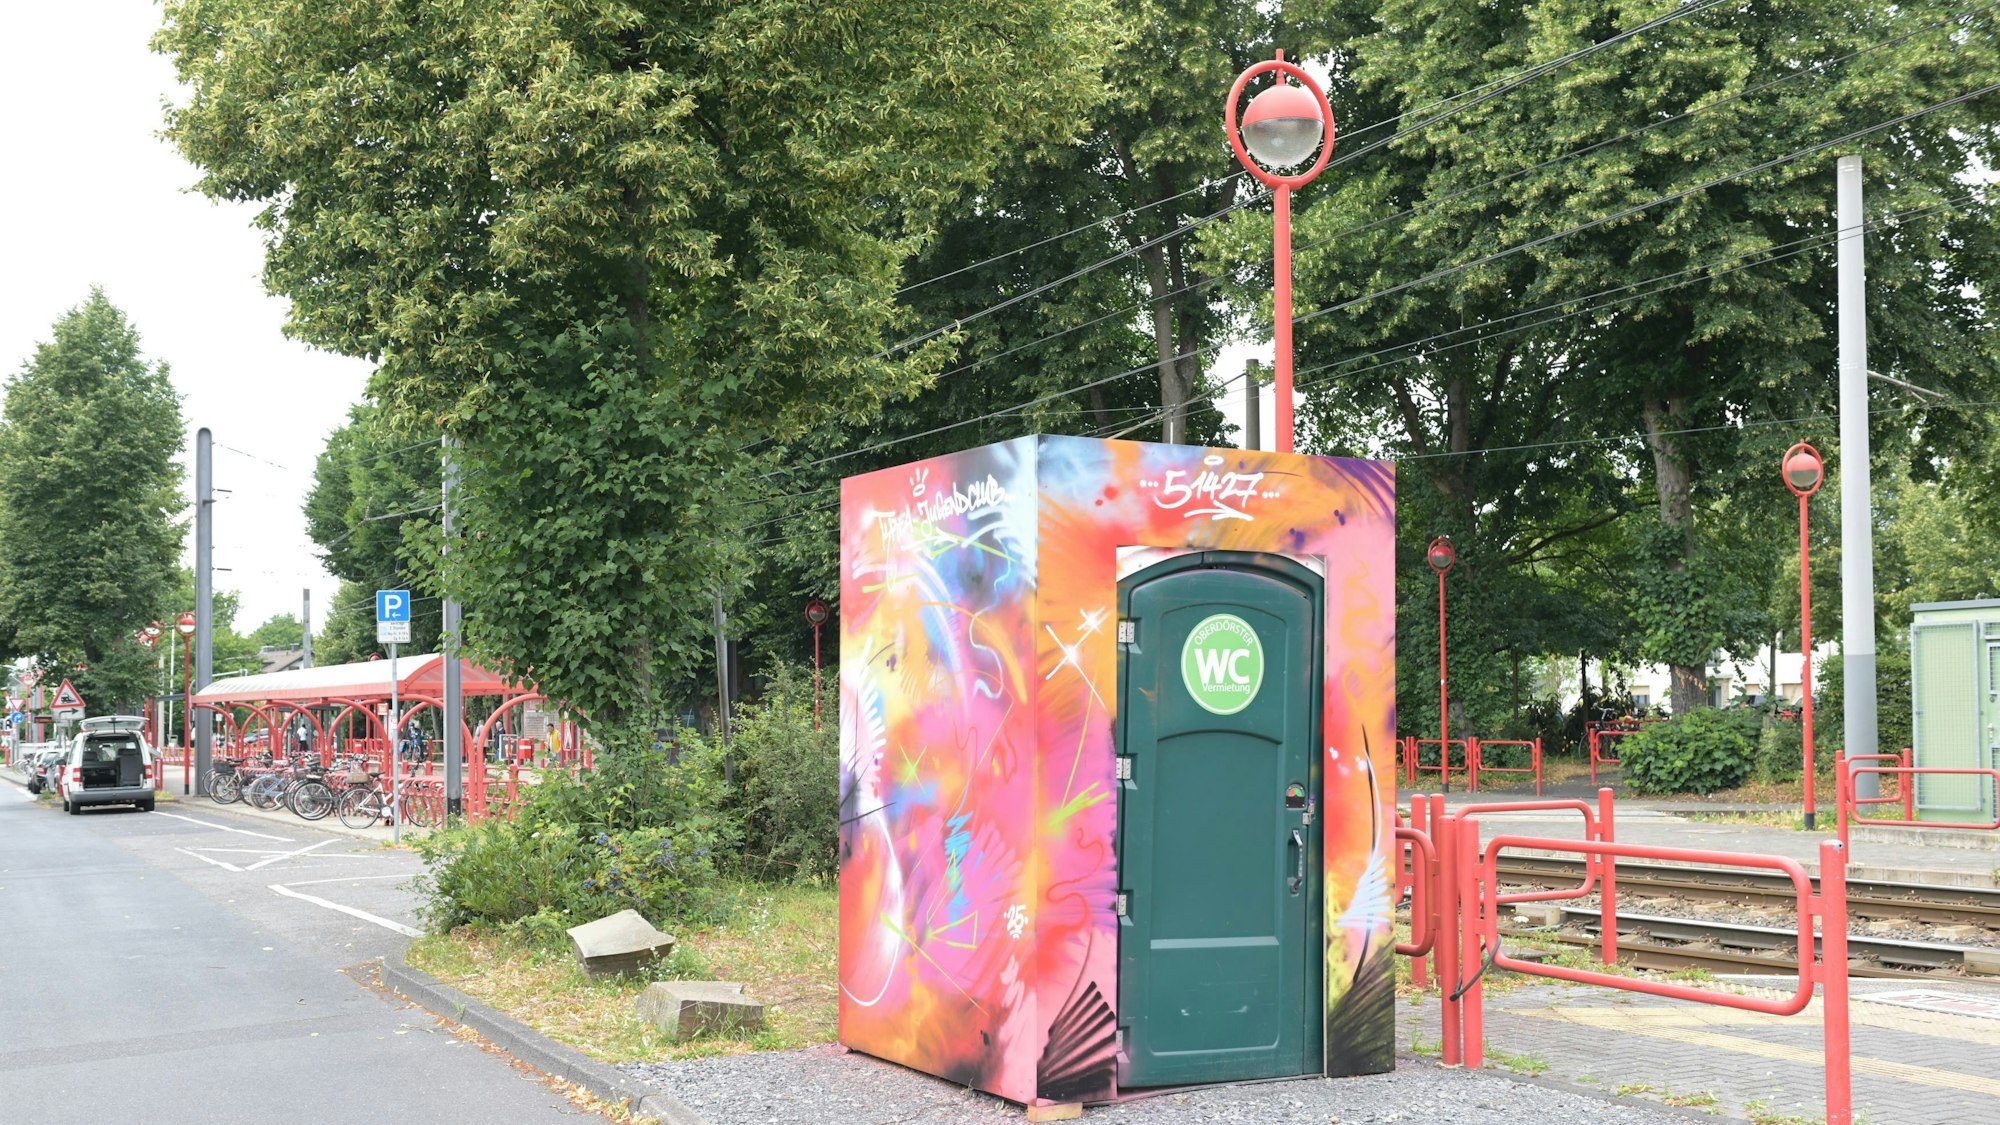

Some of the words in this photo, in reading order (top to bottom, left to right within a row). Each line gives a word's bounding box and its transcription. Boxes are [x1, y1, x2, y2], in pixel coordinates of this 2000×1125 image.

[384, 594, 402, 618] P
[1194, 619, 1253, 646] OBERDÖRSTER
[1193, 648, 1250, 685] WC
[1202, 683, 1250, 694] Vermietung
